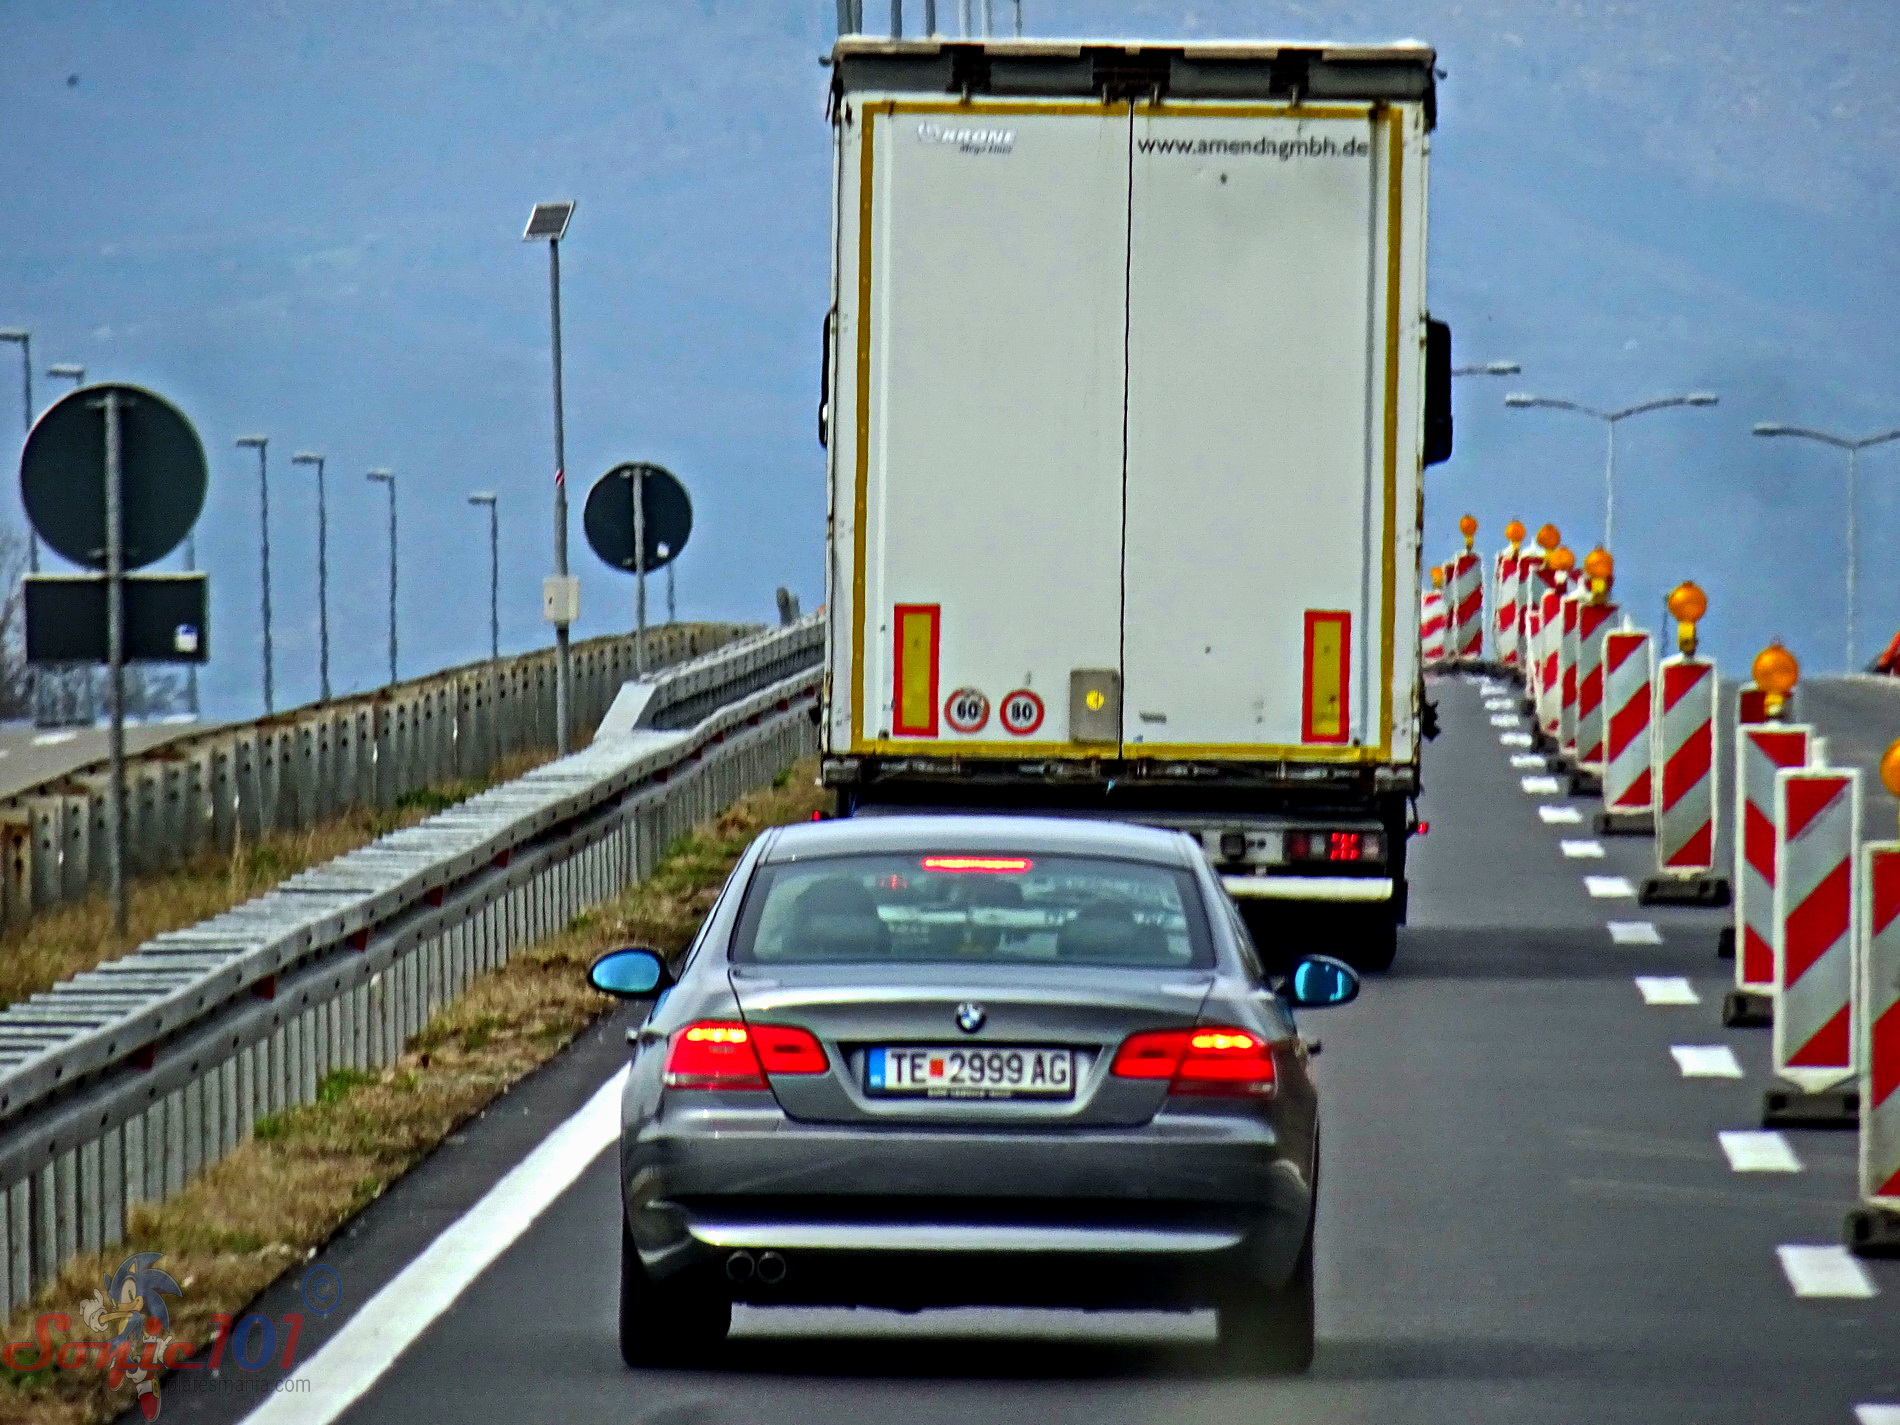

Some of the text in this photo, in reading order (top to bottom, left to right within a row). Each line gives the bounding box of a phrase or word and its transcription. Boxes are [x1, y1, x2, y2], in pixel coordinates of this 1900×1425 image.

[1011, 701, 1033, 722] 80
[891, 1052, 1067, 1085] TE 2999 AG
